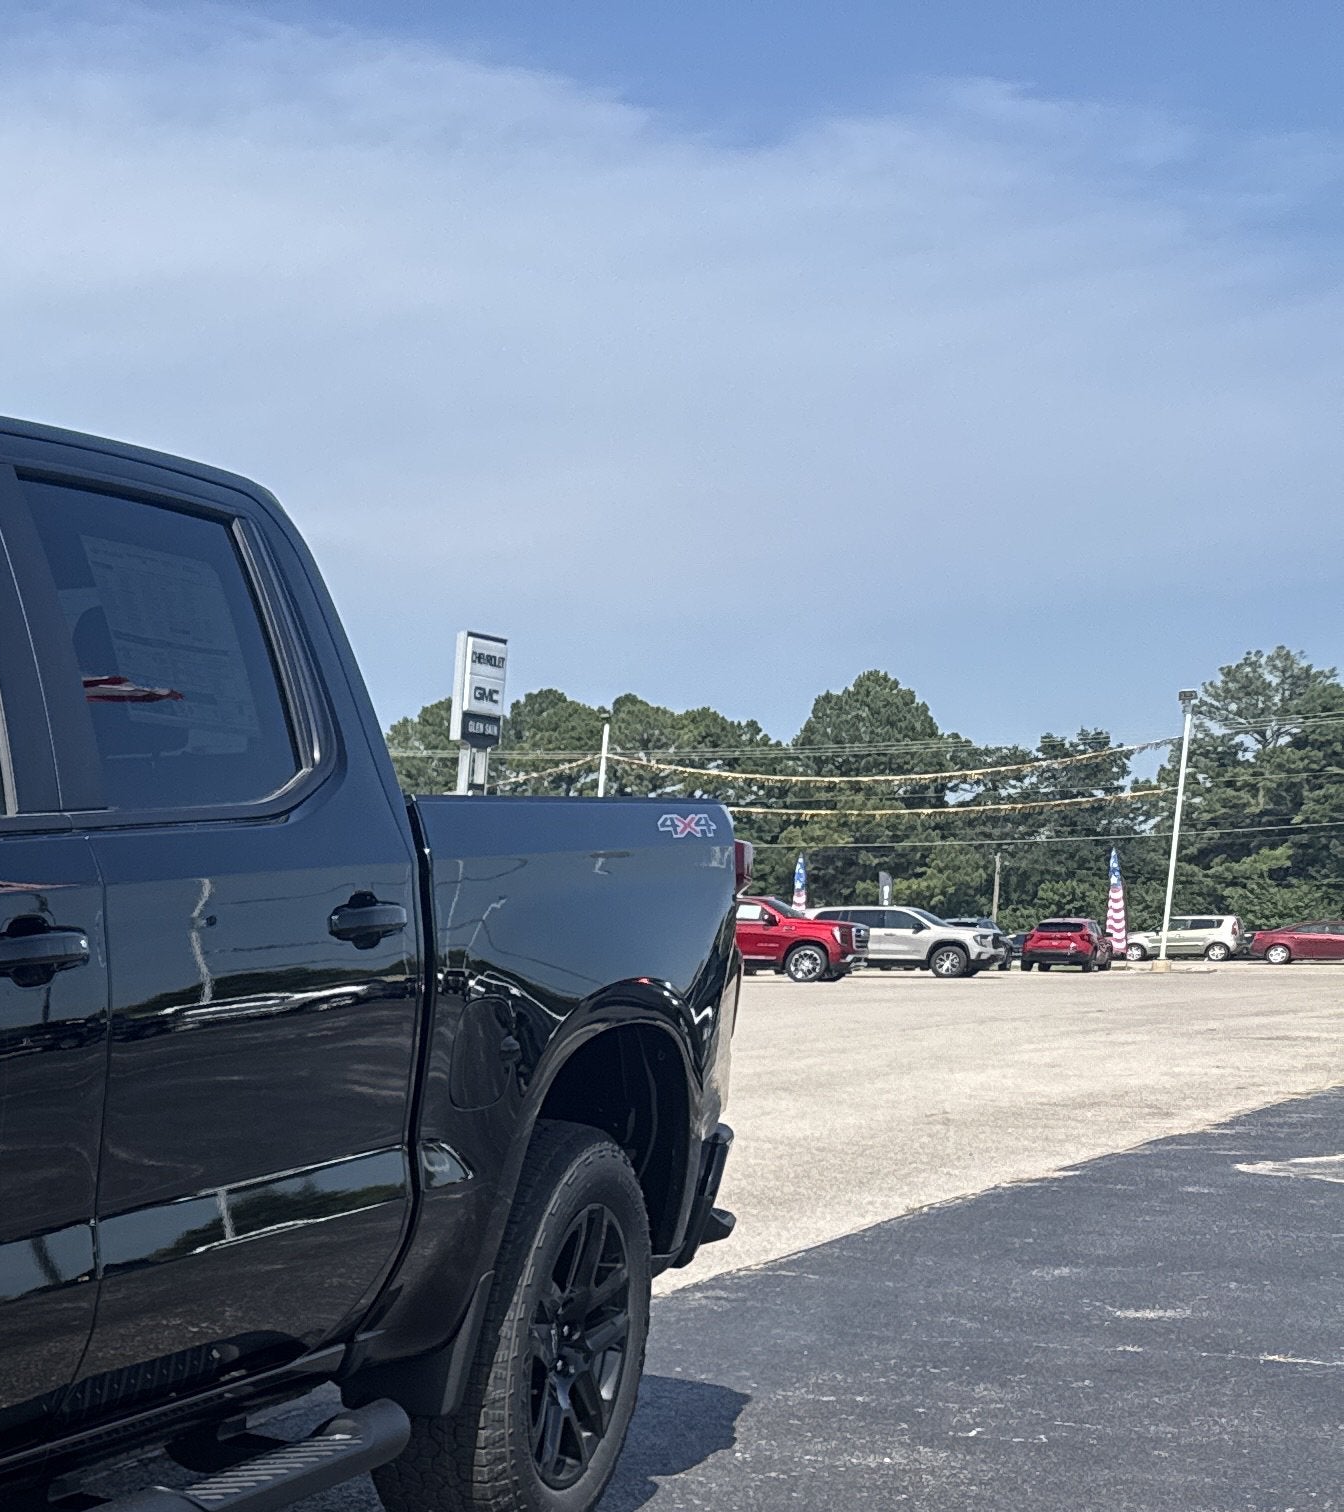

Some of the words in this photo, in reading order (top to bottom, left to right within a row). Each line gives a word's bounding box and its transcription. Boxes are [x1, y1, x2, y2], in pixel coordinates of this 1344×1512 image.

[472, 651, 505, 668] CHEVROLET
[473, 686, 499, 704] GMC
[468, 720, 484, 735] GLEN
